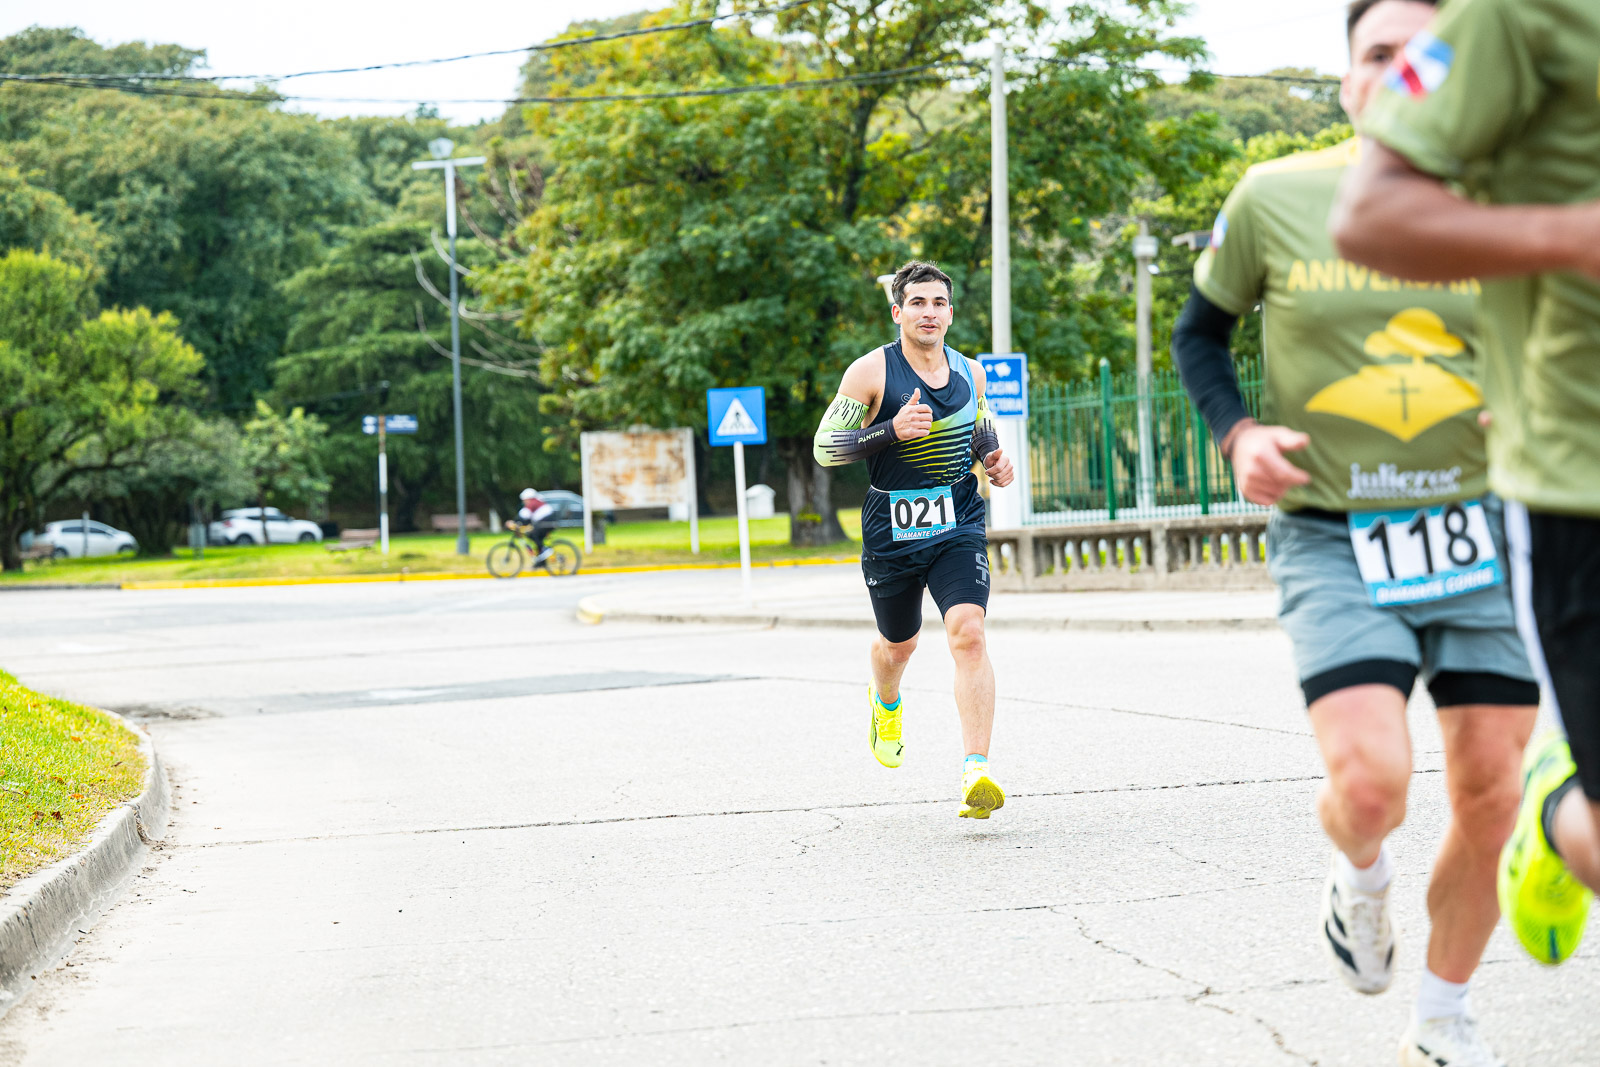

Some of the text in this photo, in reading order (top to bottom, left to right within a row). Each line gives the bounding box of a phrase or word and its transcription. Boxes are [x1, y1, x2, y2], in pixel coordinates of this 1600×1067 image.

[858, 429, 885, 444] PANTRO
[895, 494, 947, 530] 021
[896, 531, 931, 539] DIAMANTE
[1369, 505, 1478, 579] 118
